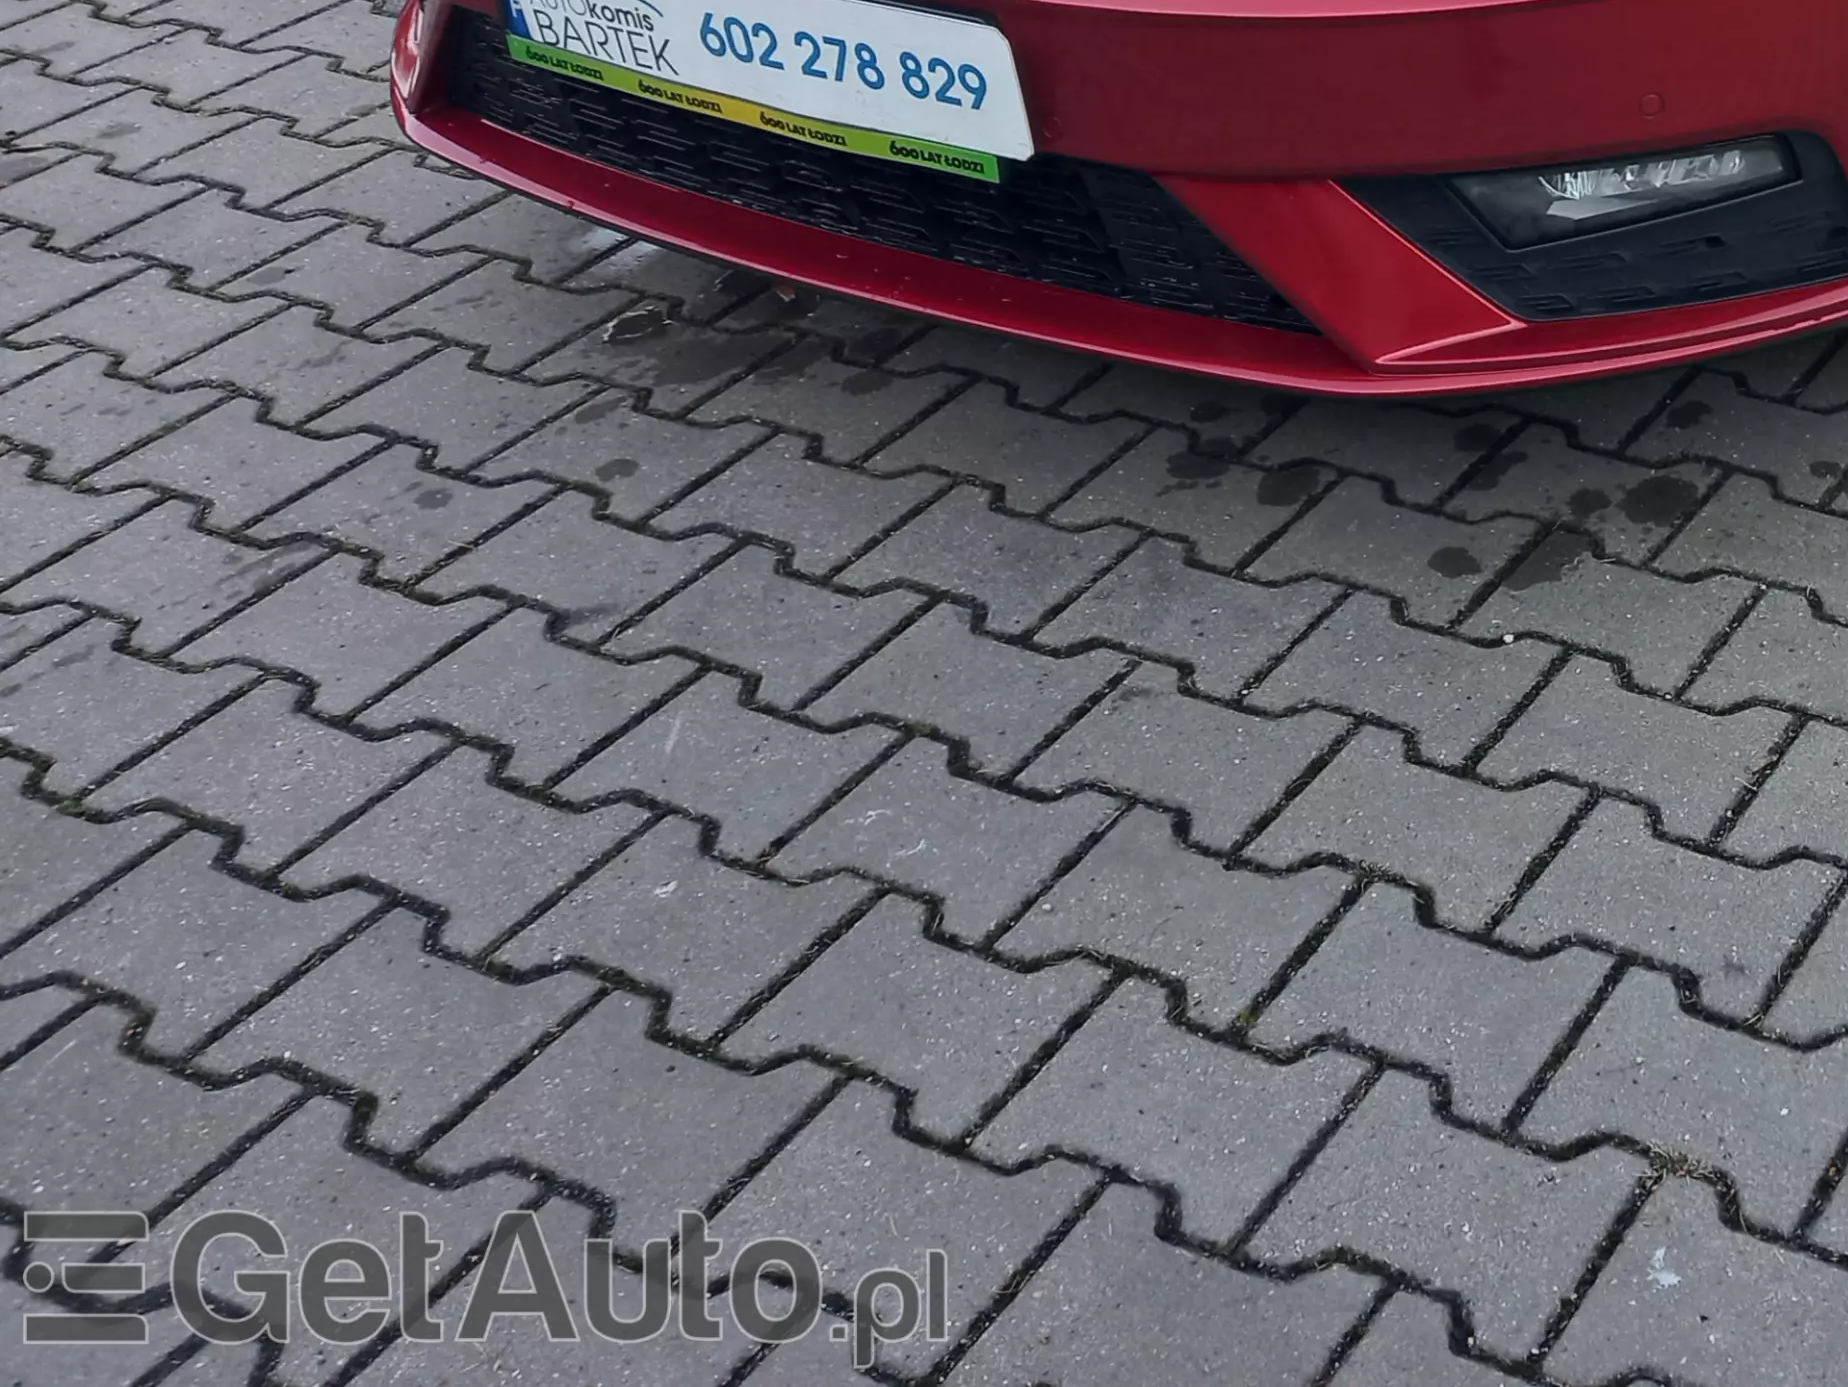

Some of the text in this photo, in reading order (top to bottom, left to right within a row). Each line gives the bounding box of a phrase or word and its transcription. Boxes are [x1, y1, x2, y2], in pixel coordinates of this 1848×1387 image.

[533, 9, 680, 76] BARTEK
[700, 11, 988, 110] 602 278 829
[638, 79, 664, 98] 600
[664, 89, 684, 104] LAT
[760, 111, 786, 131] 600
[786, 121, 807, 137] LAT
[889, 140, 919, 160] 600
[919, 149, 943, 166] LAT
